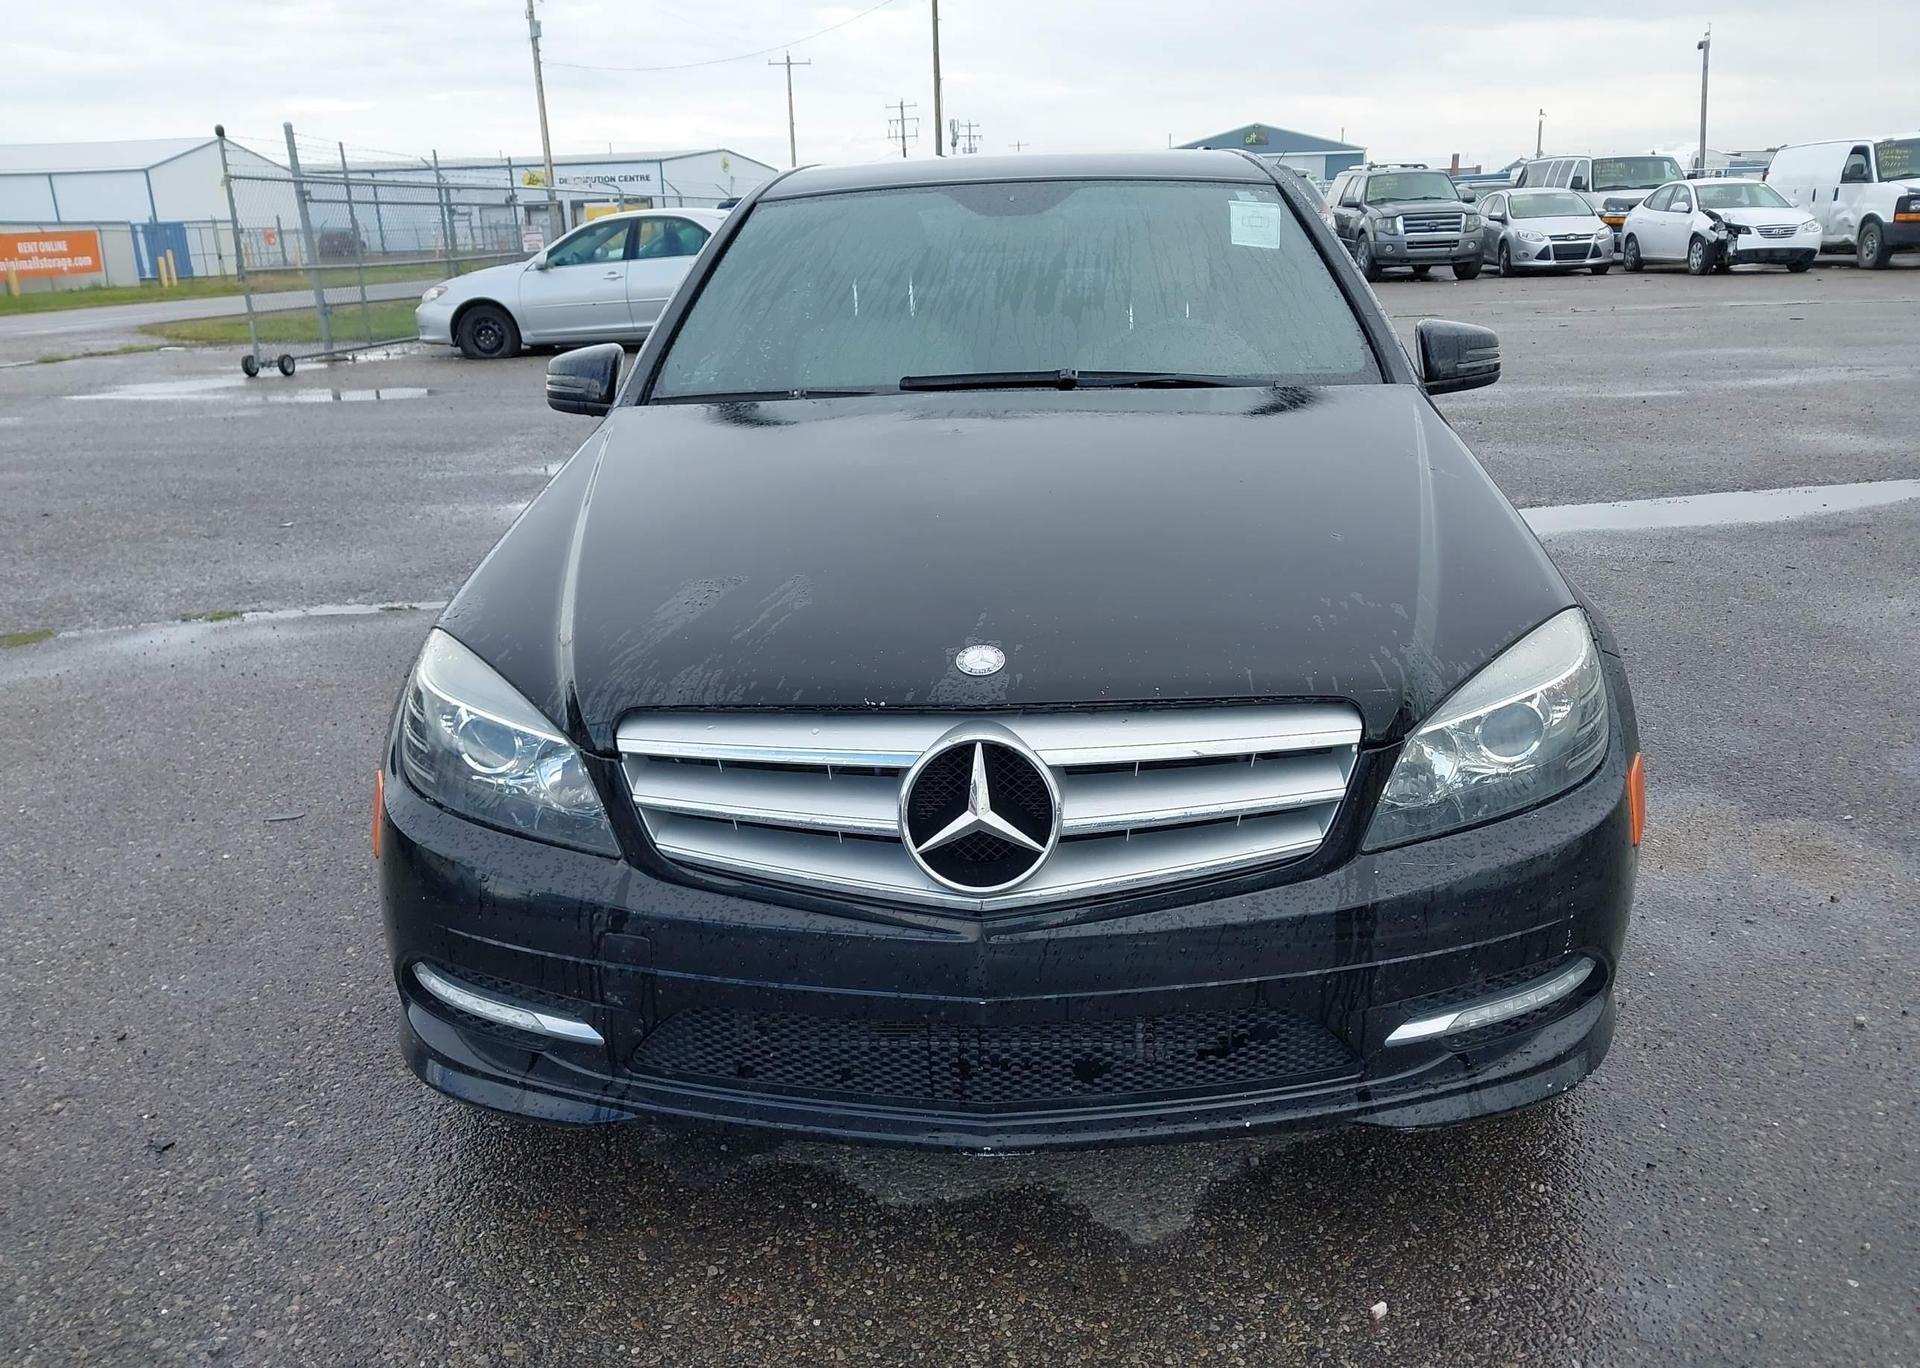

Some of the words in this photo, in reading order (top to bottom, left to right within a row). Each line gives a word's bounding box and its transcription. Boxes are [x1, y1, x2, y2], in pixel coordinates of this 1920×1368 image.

[559, 175, 616, 184] DIUTION
[618, 174, 651, 182] CENTRE
[17, 241, 38, 253] RENT
[39, 240, 68, 252] ONLINE
